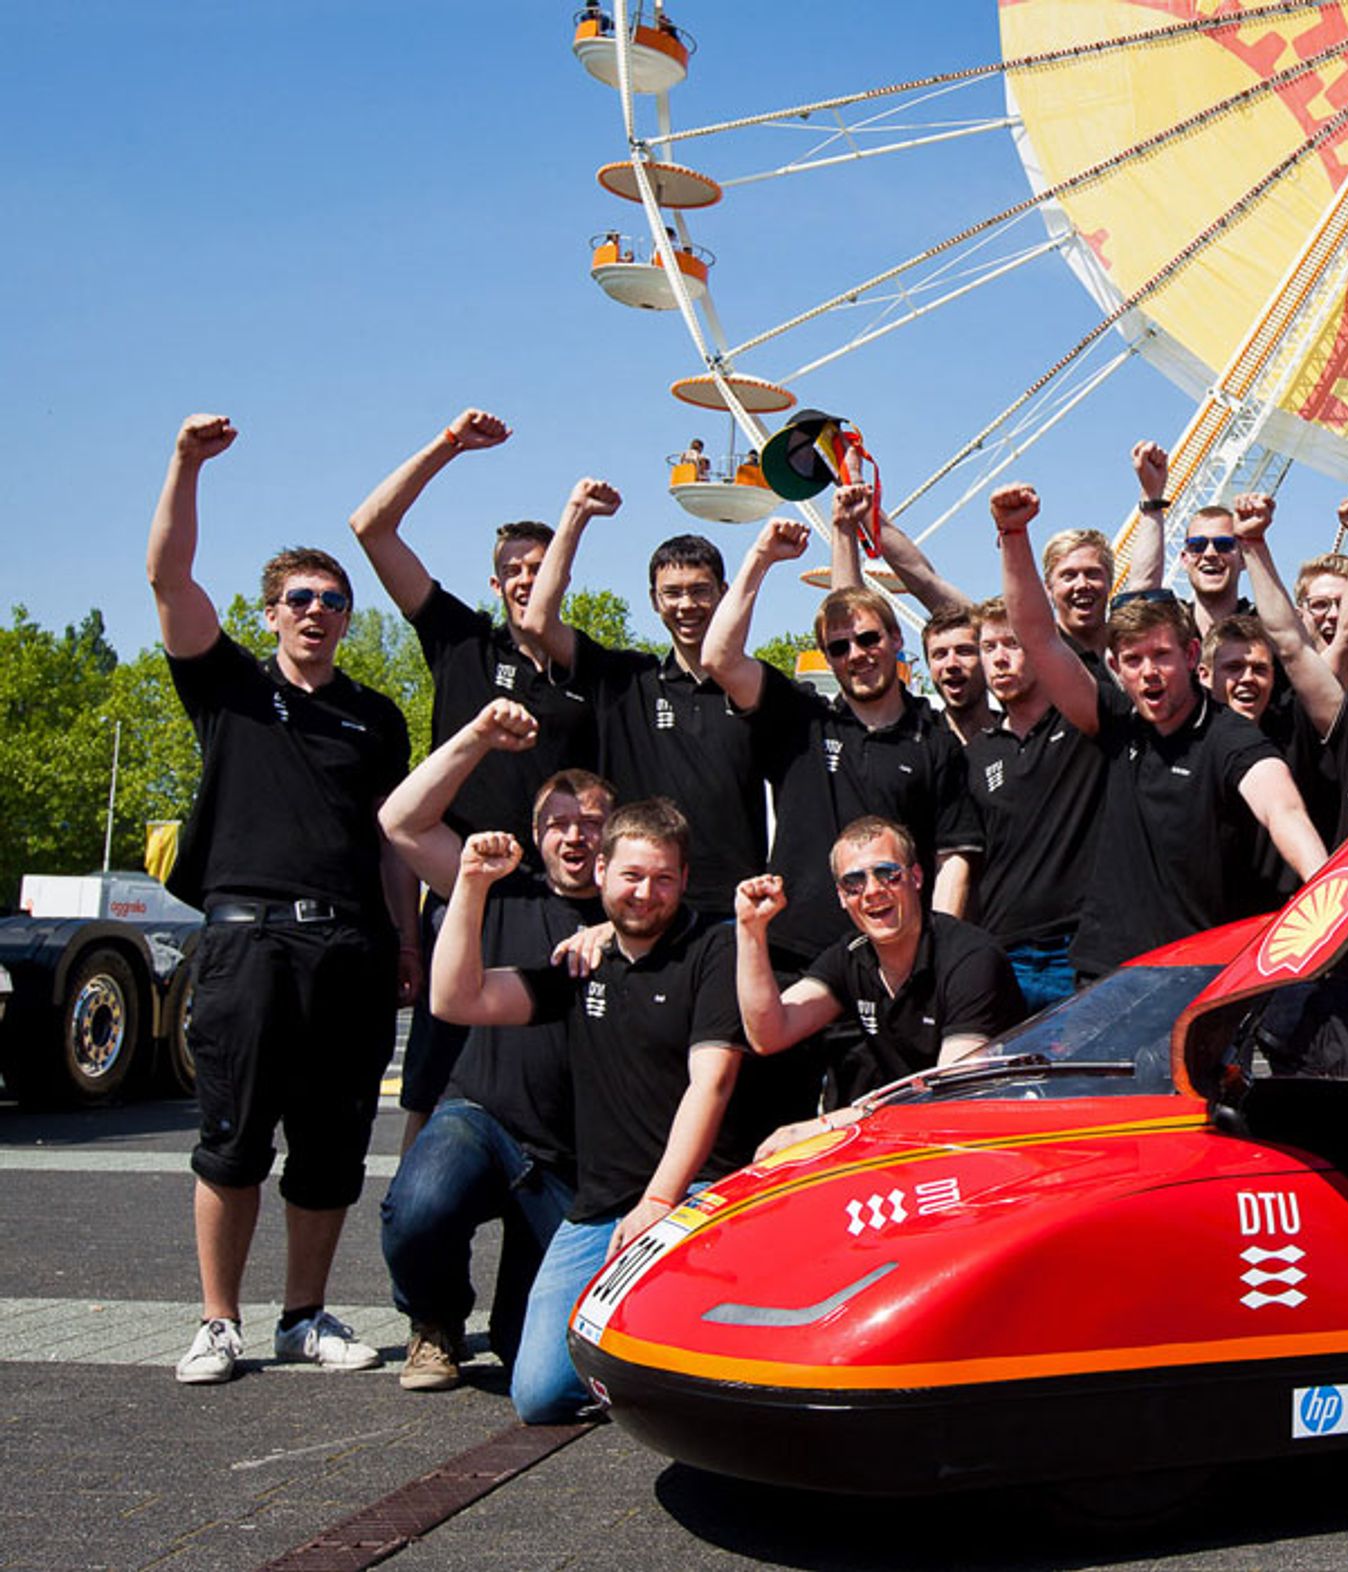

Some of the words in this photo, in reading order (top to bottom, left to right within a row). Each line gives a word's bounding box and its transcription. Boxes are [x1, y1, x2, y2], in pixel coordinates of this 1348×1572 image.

[915, 1177, 961, 1216] DTU
[1237, 1191, 1301, 1235] DTU
[1304, 1386, 1340, 1433] hp
